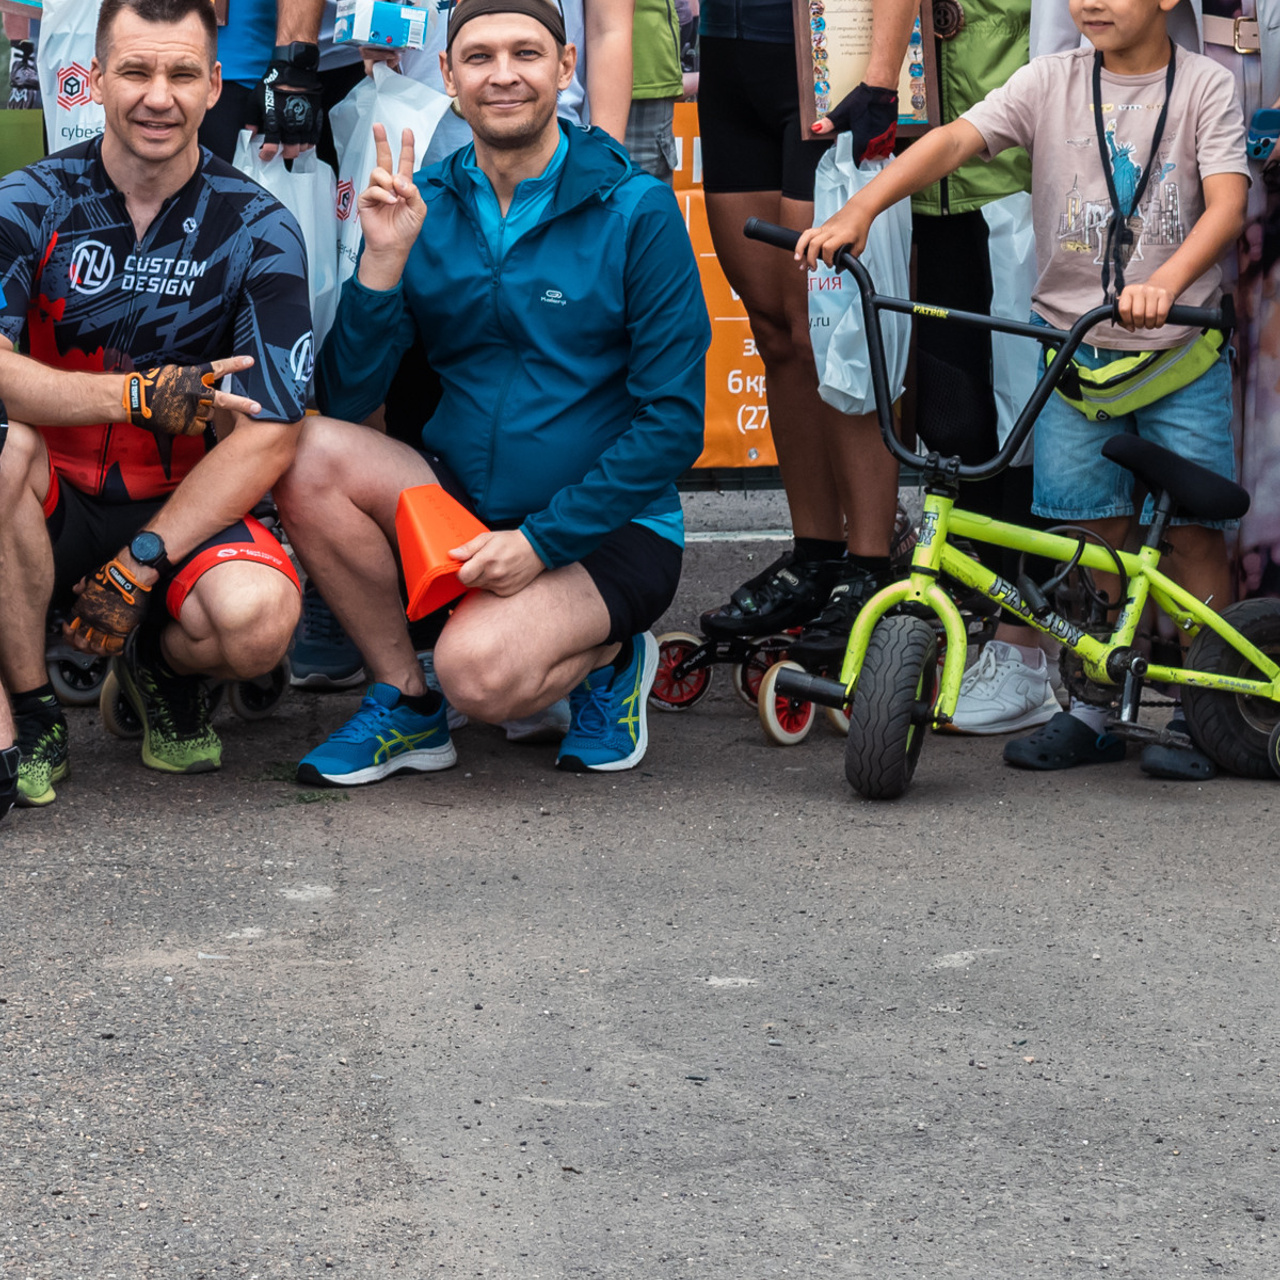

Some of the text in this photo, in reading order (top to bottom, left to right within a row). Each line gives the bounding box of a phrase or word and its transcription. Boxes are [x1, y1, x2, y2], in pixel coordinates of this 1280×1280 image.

[123, 255, 207, 278] CUSTOM
[121, 274, 196, 297] DESIGN
[808, 276, 842, 291] ГИЯ
[727, 369, 744, 394] 6
